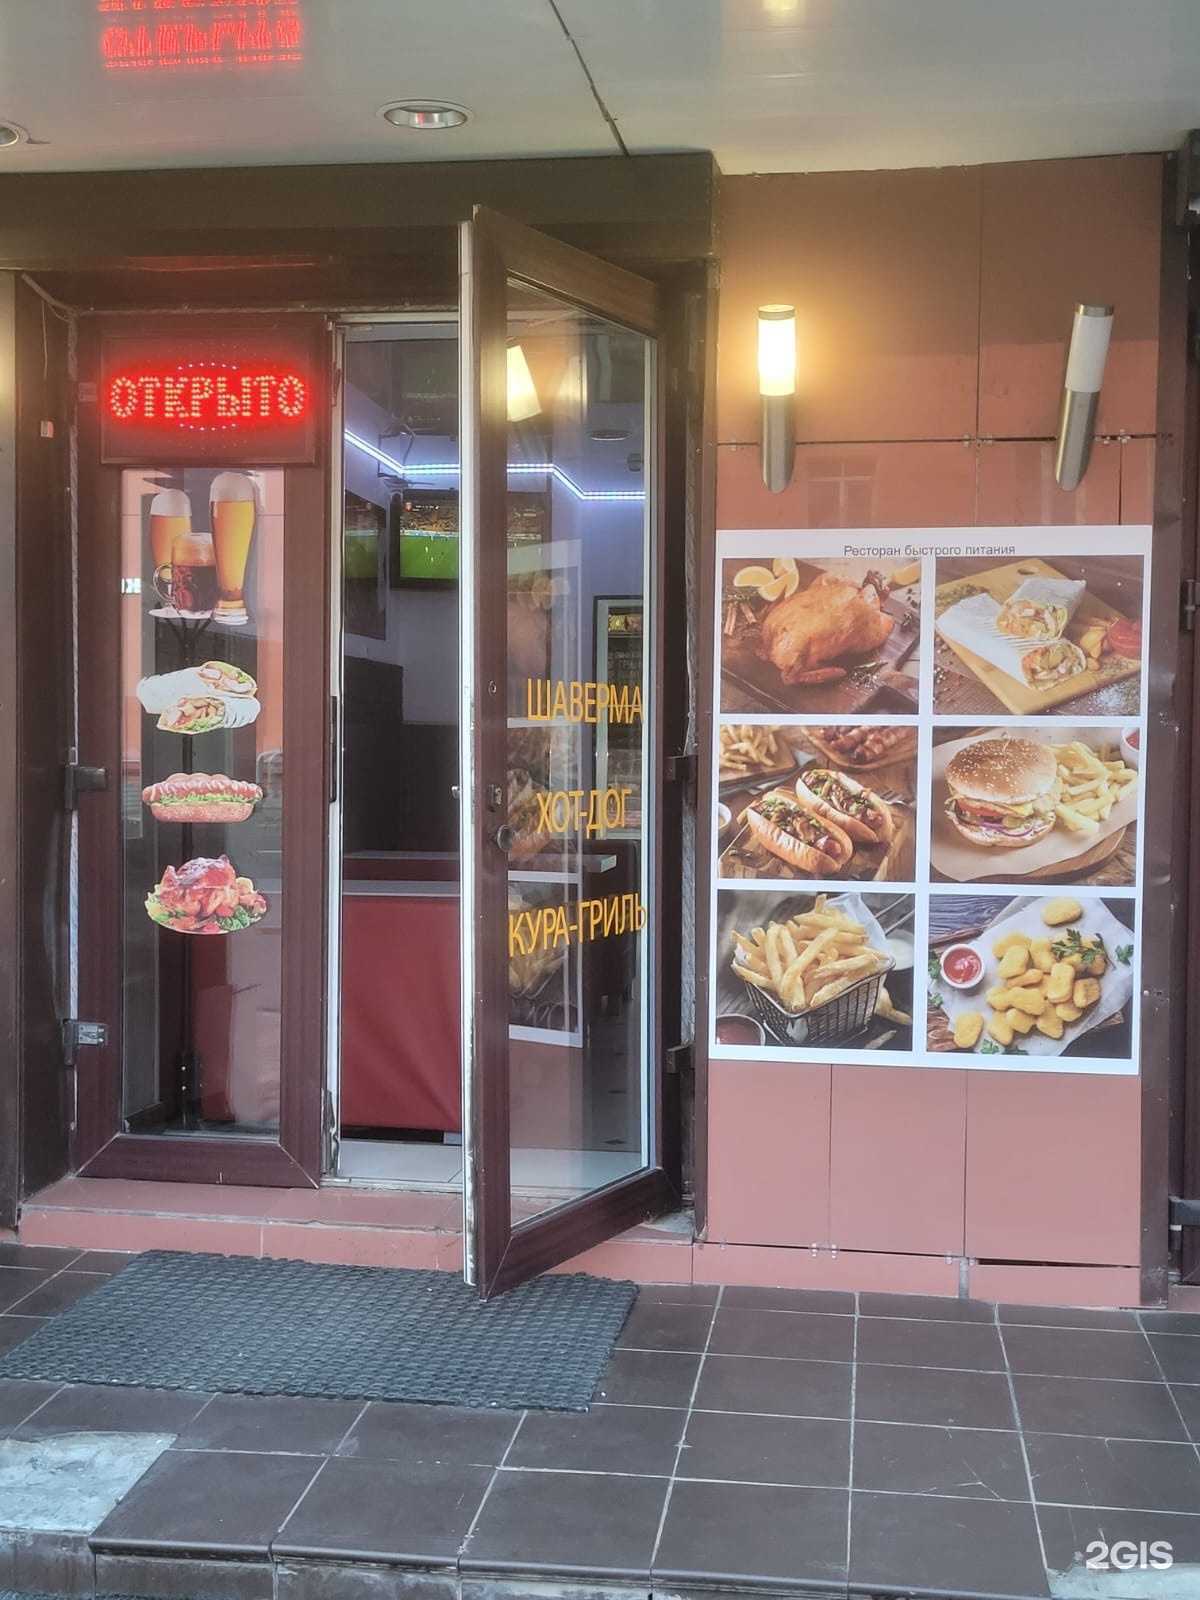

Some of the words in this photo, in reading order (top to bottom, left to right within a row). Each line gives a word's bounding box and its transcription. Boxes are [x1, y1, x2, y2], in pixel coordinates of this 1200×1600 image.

[111, 375, 304, 417] ОТКРЫТО
[843, 545, 900, 558] Ресторан
[904, 545, 961, 558] быстрого
[965, 545, 1016, 556] питания
[527, 678, 645, 724] ШАВЕРМА
[536, 788, 632, 839] ХОТ-ДОГ
[508, 893, 647, 957] КУРА-ГРИЛЬ
